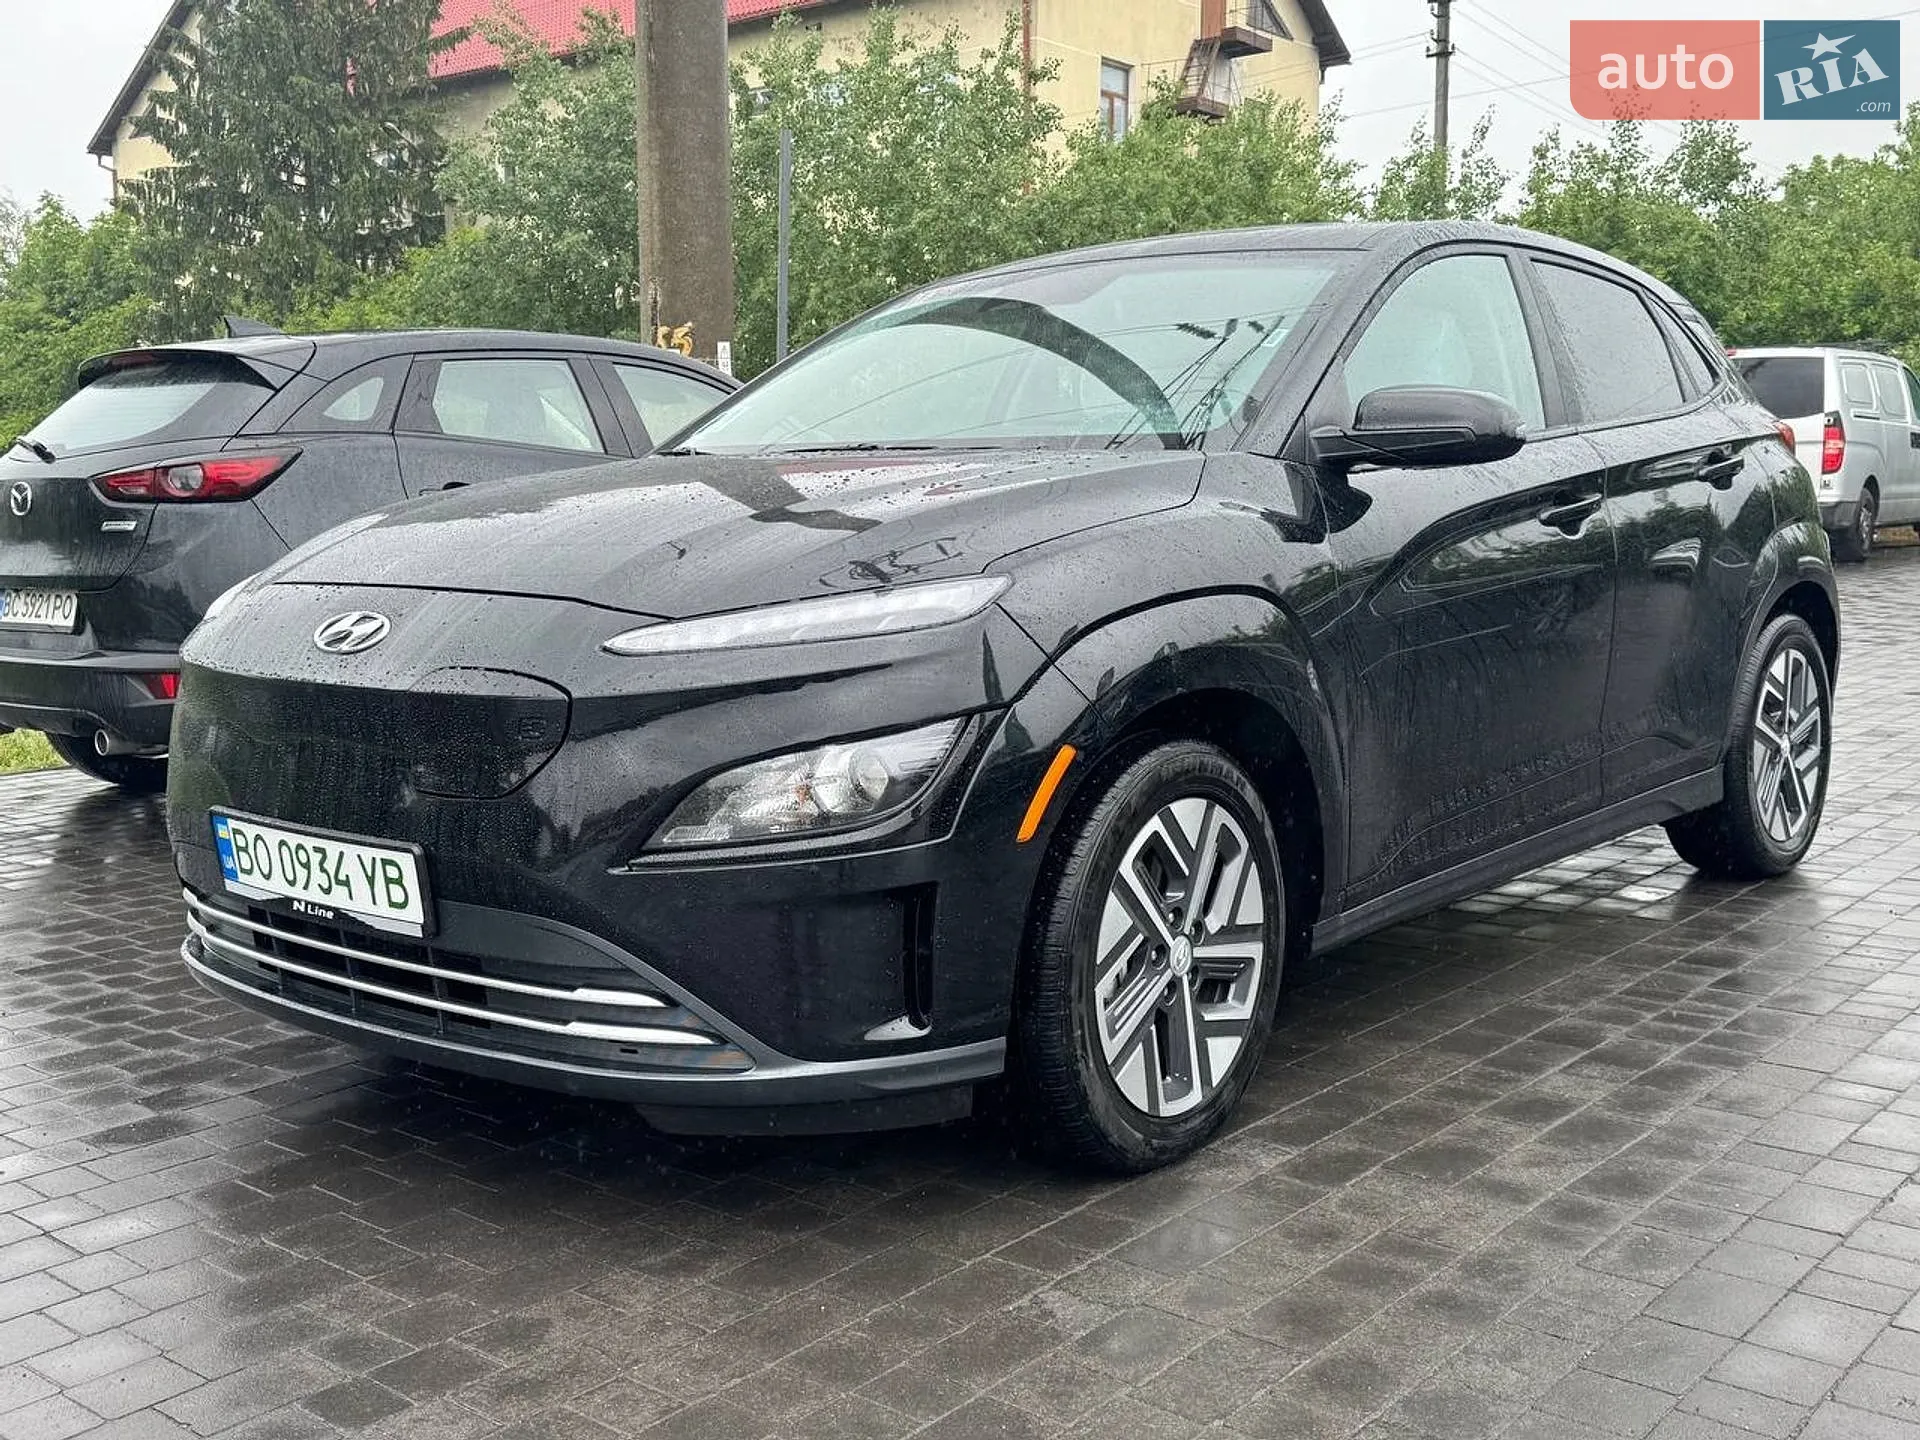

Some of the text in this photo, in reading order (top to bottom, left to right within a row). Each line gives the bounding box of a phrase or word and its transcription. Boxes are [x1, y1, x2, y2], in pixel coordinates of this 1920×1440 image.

[3, 590, 74, 620] BC 5921 PO
[222, 854, 237, 870] UA
[231, 827, 410, 910] BO 0934 YB
[292, 900, 335, 920] N Line
